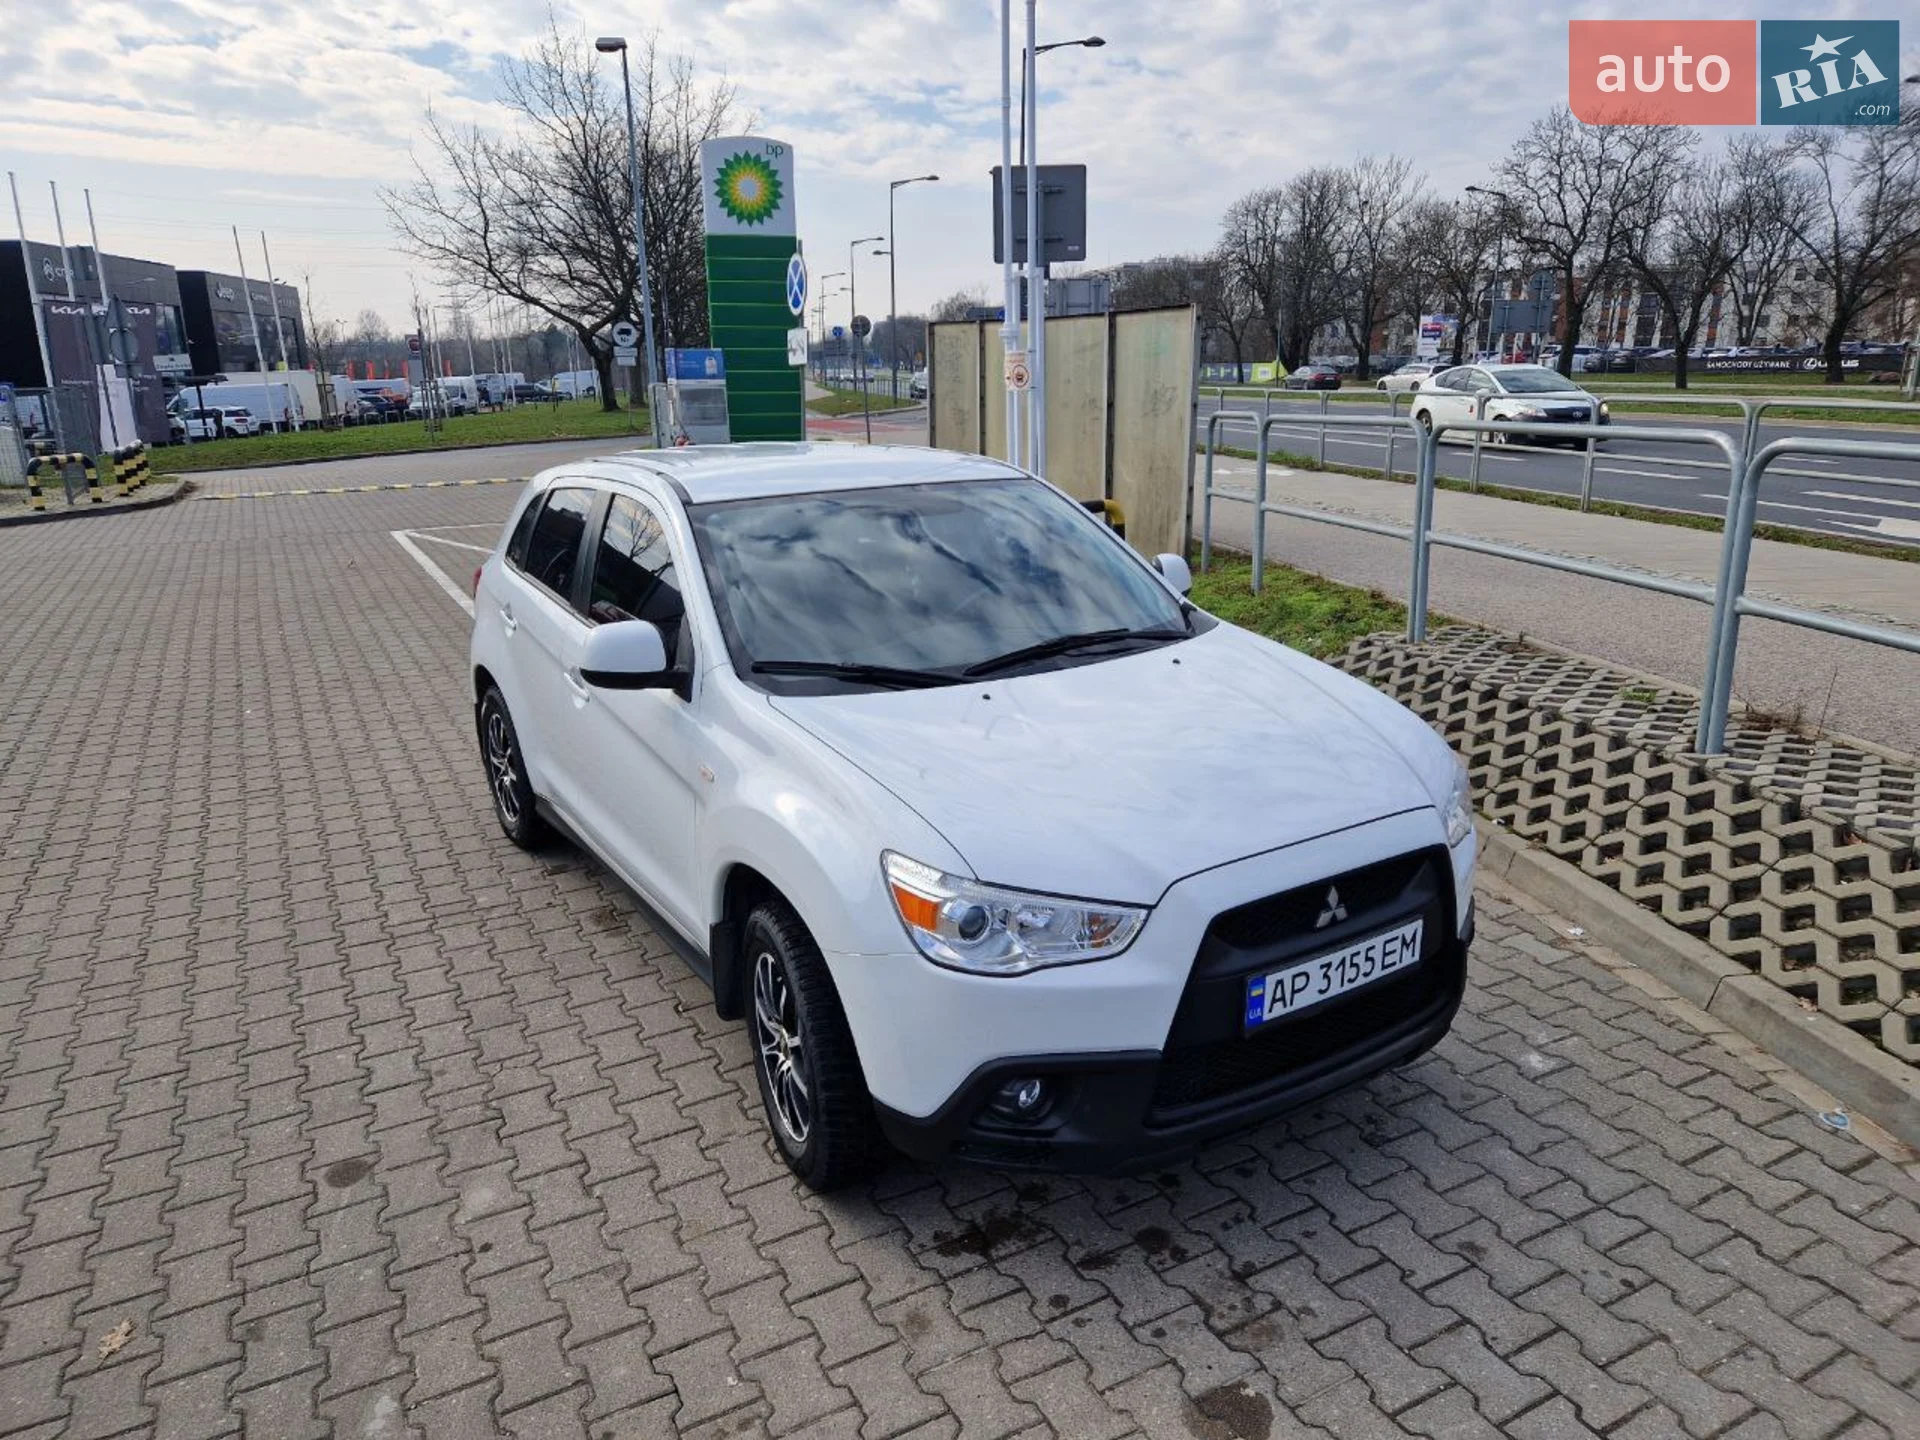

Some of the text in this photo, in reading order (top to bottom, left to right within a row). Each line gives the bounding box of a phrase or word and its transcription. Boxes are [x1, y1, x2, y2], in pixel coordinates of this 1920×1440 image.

[766, 142, 784, 158] bp
[51, 305, 85, 315] KIA
[1706, 360, 1752, 369] SAMOCHODY
[1817, 359, 1860, 367] LUS
[1268, 927, 1418, 1014] AP 3155 EM
